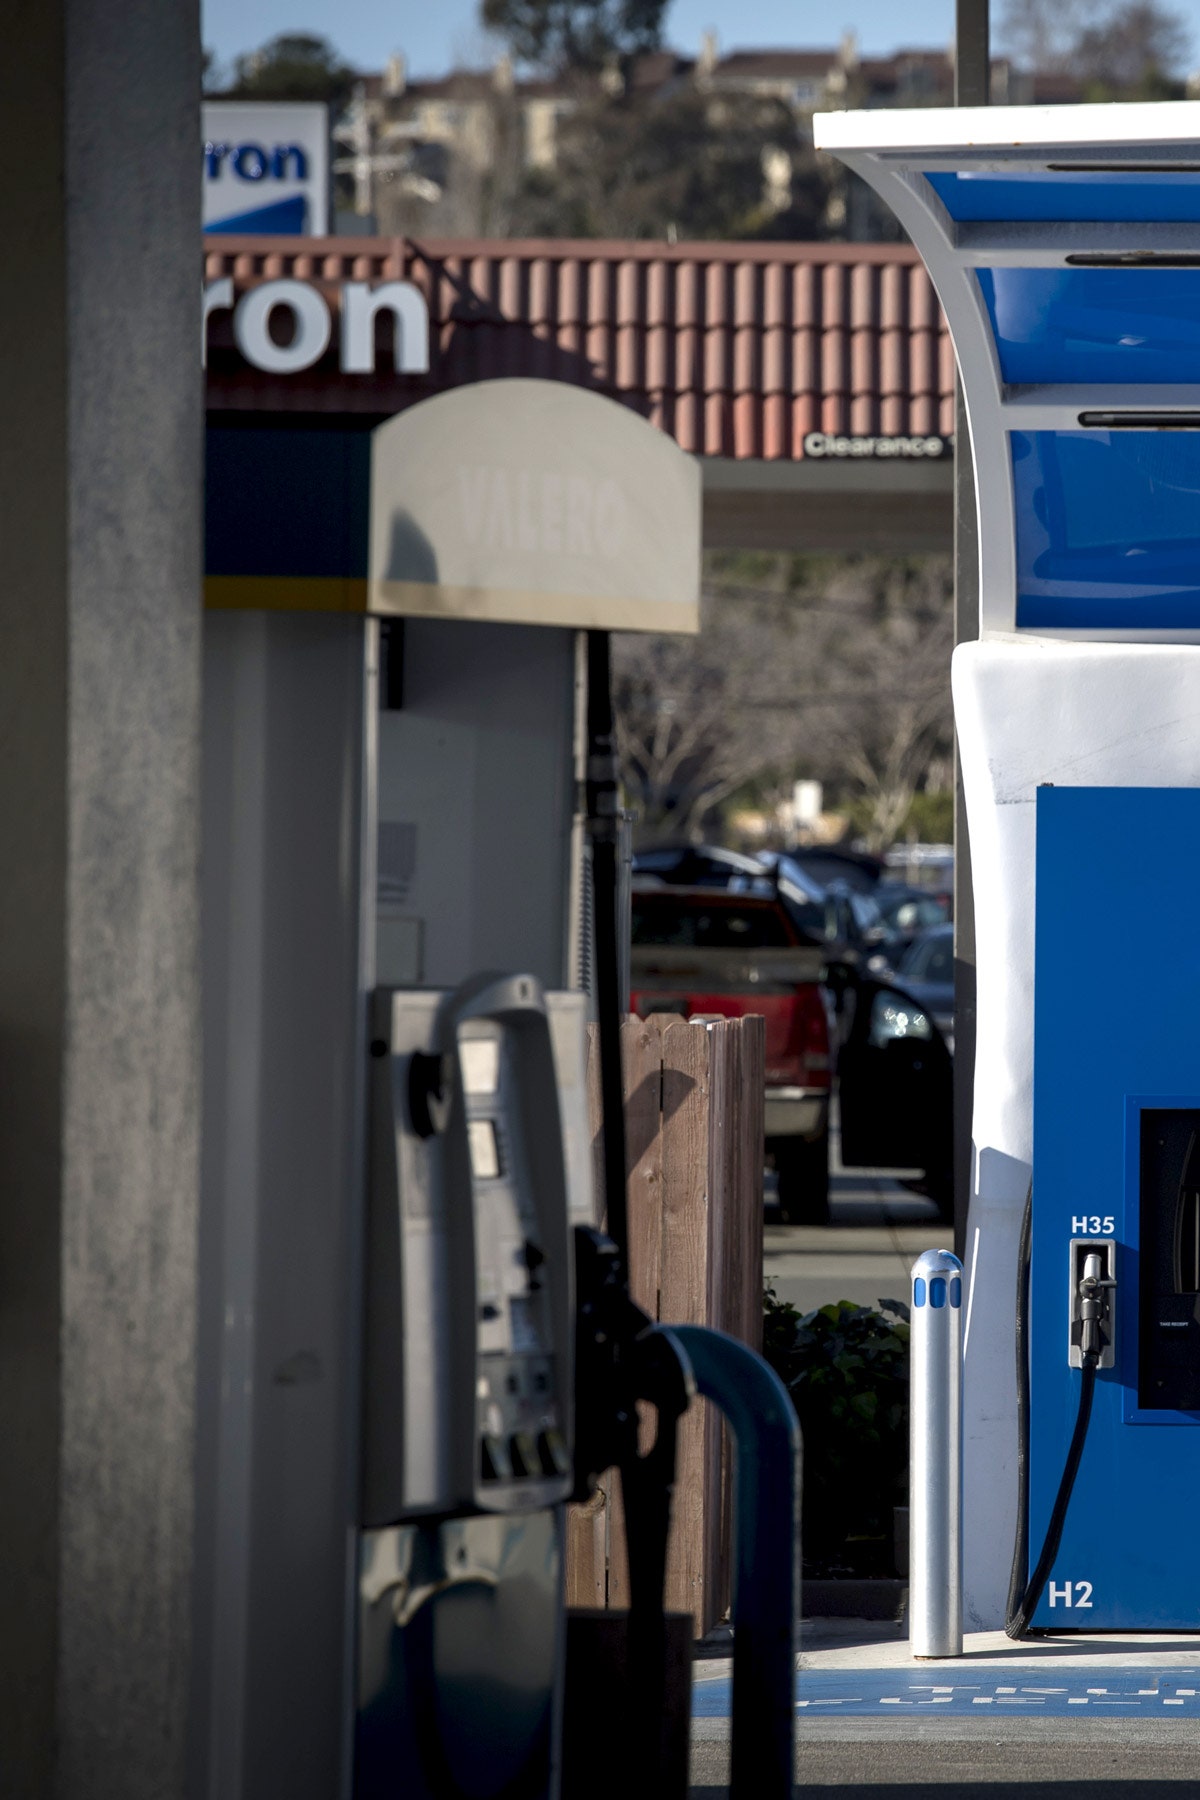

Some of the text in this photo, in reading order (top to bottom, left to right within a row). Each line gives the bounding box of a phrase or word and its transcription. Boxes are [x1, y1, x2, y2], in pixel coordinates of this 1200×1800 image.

[804, 432, 943, 457] Clearance
[456, 465, 627, 556] VALERO
[1072, 1216, 1115, 1234] H35
[1049, 1581, 1093, 1607] H2
